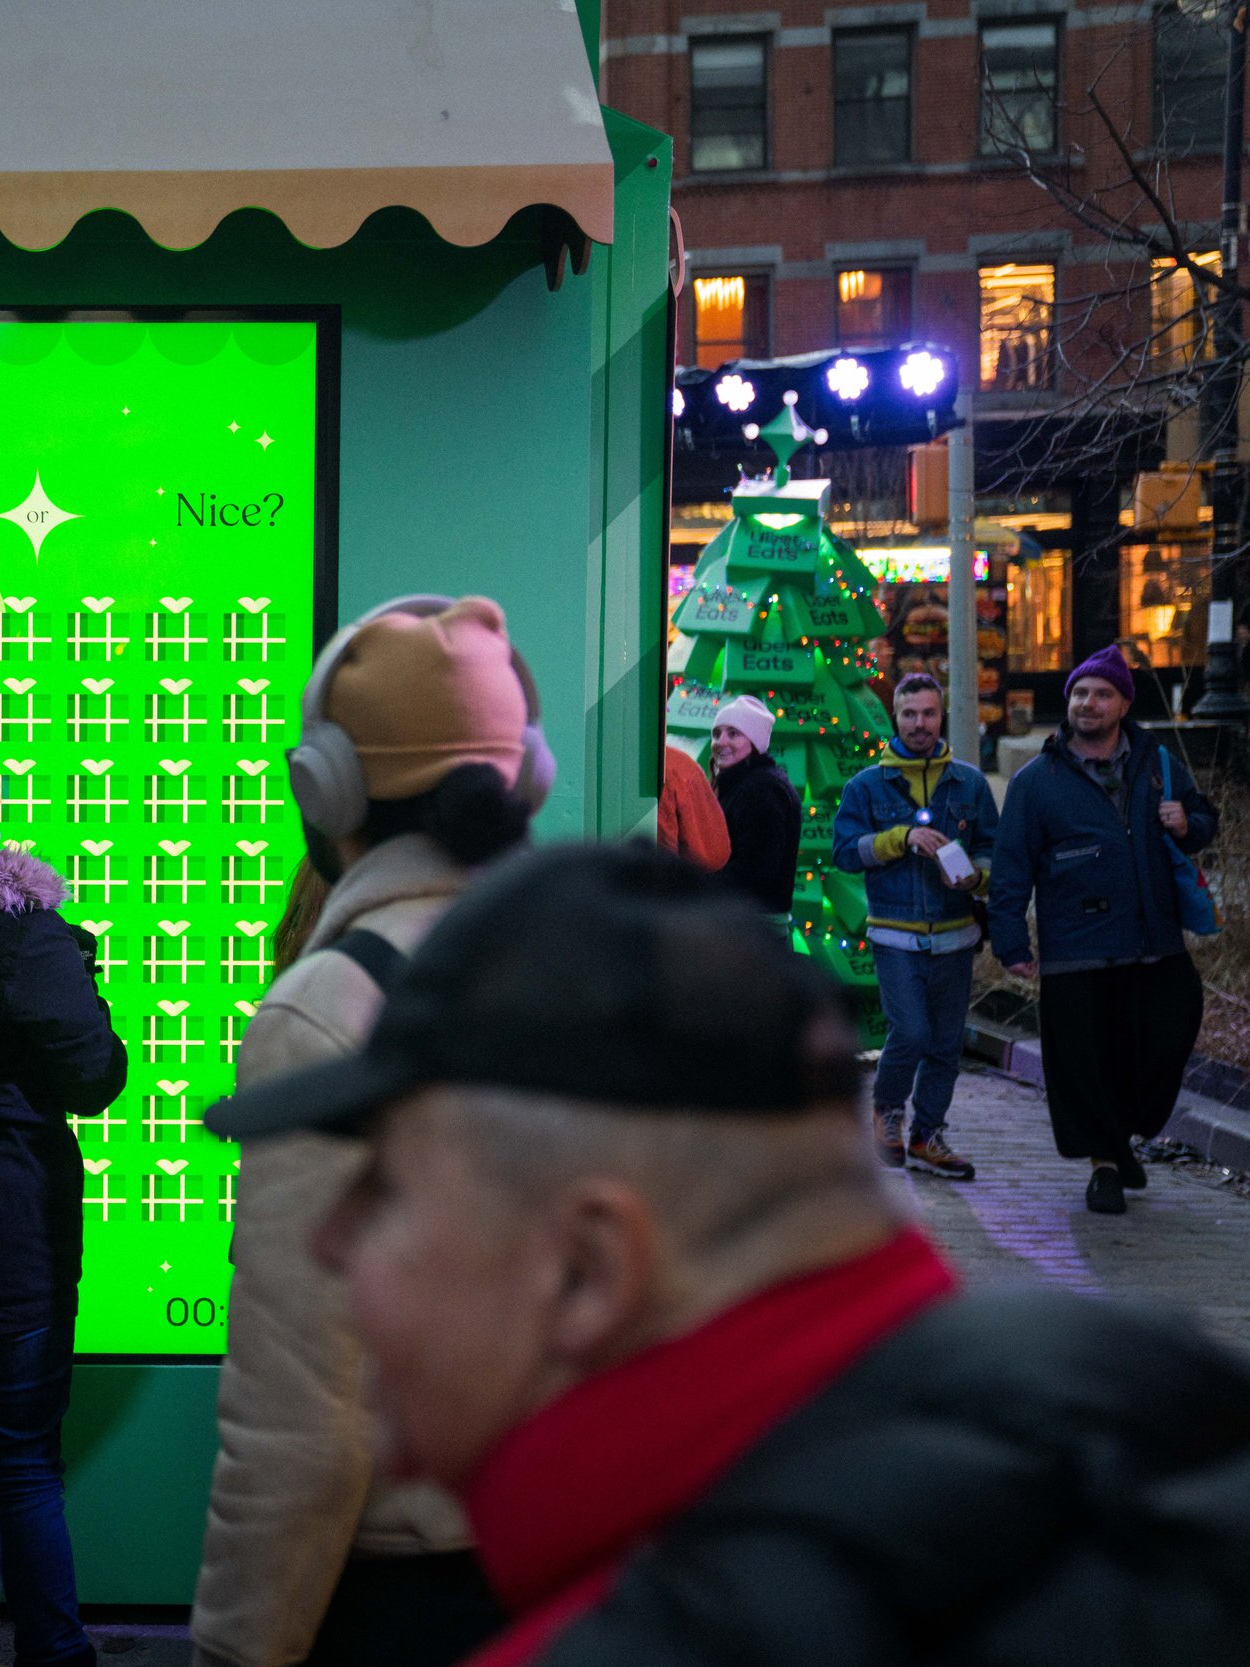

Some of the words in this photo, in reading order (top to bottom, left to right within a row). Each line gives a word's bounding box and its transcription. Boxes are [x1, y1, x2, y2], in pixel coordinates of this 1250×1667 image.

[26, 510, 49, 523] or
[176, 492, 285, 527] Nice?
[747, 545, 798, 561] Eats
[810, 609, 849, 626] Eats
[743, 638, 790, 653] Uber
[743, 653, 794, 672] Eats
[803, 827, 833, 840] ats
[166, 1297, 228, 1327] 00:
